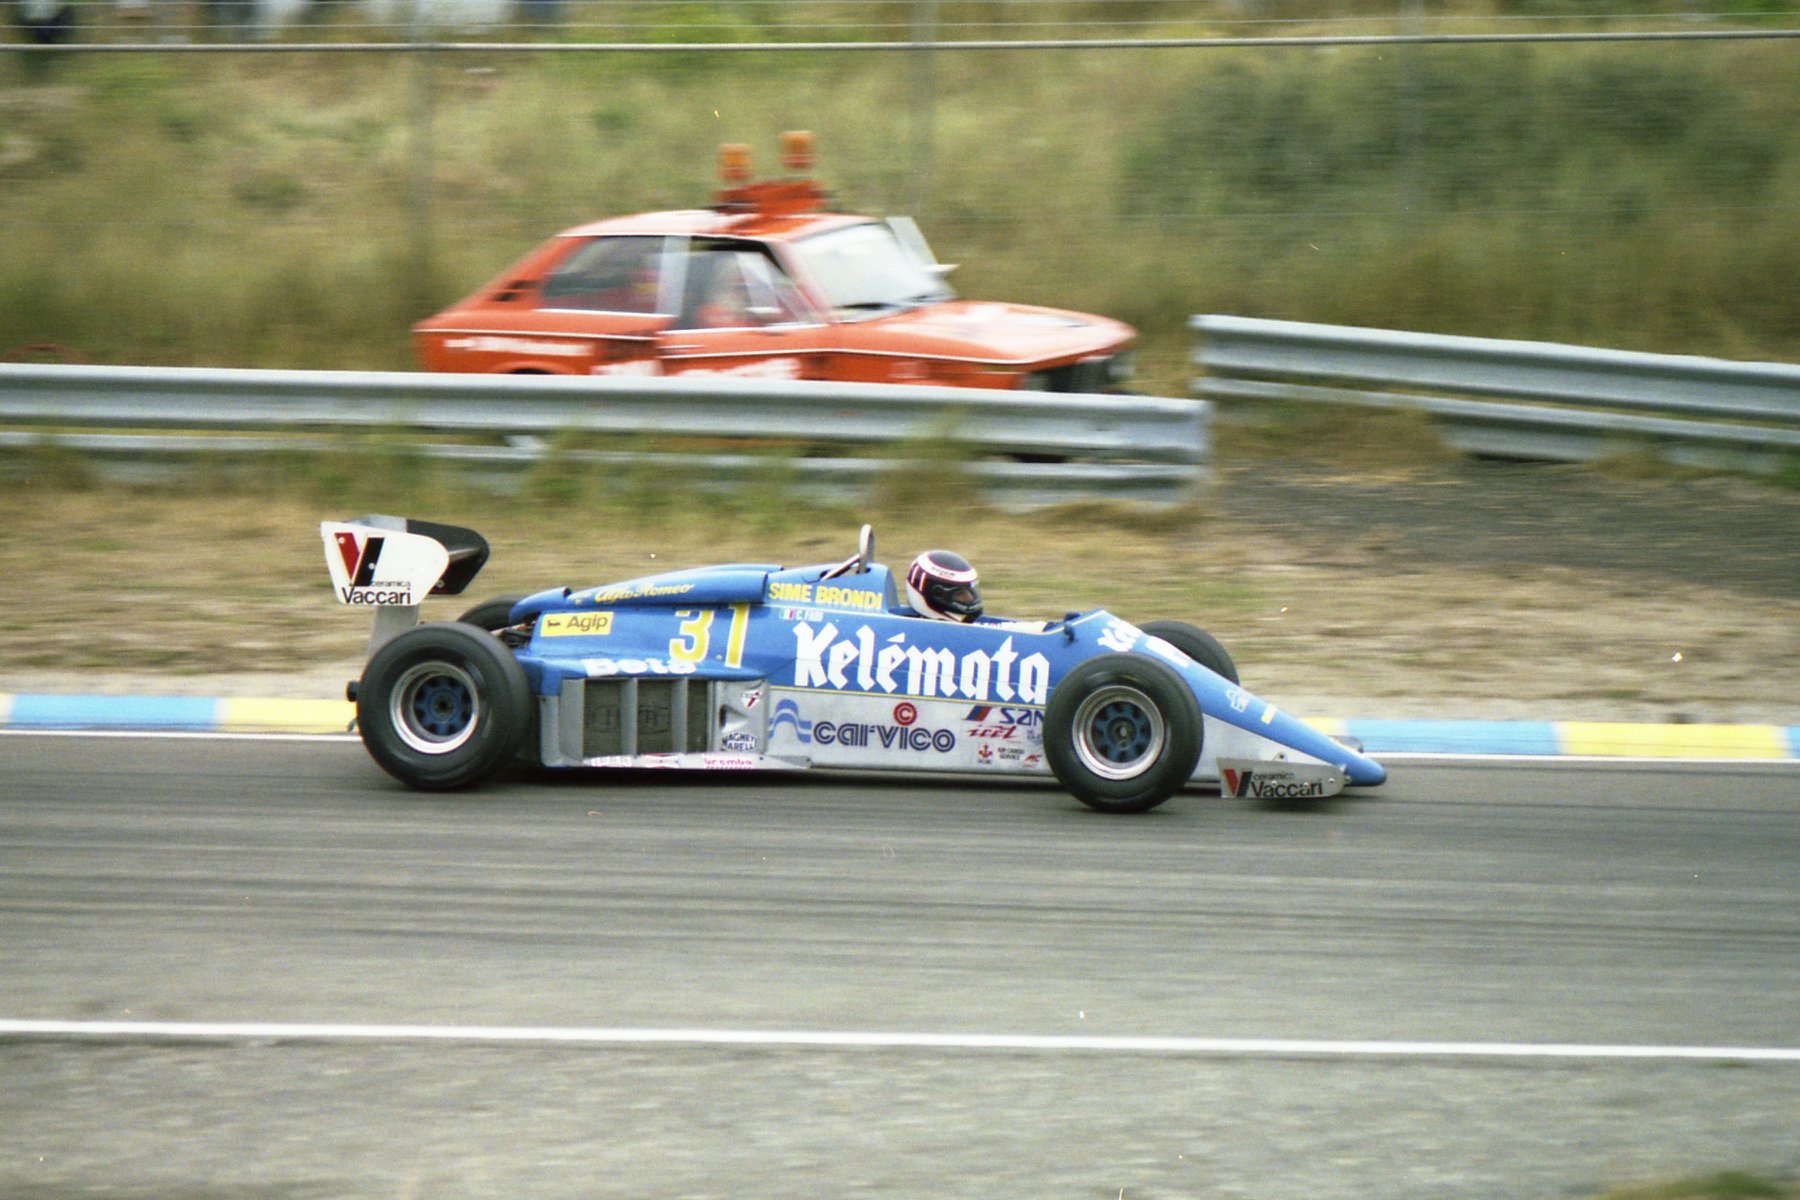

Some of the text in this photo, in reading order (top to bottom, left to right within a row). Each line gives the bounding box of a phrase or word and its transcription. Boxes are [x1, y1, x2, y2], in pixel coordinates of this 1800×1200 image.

[342, 587, 411, 604] Vaccari
[768, 582, 882, 610] SIME BRONDI
[567, 614, 608, 632] Agip
[668, 603, 751, 668] 31
[793, 621, 1050, 704] Kelémata
[813, 720, 956, 753] carvico
[1251, 779, 1322, 798] Vaccari
